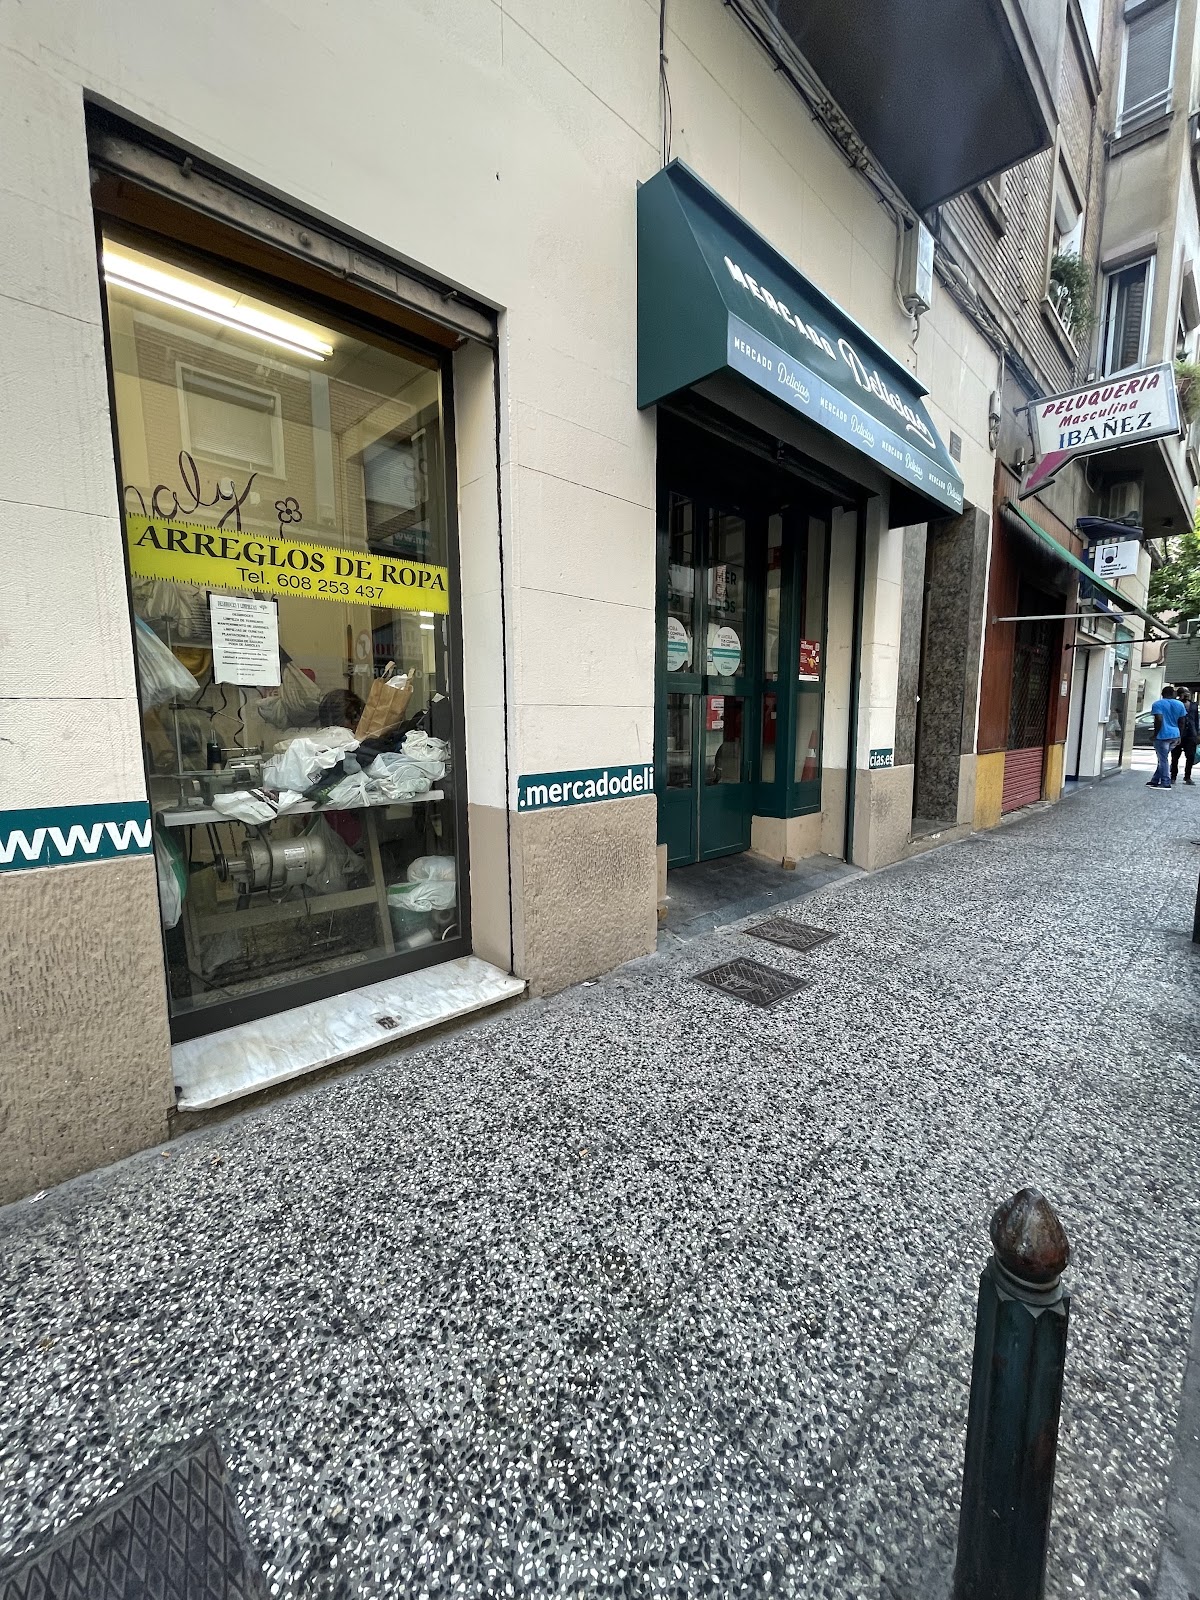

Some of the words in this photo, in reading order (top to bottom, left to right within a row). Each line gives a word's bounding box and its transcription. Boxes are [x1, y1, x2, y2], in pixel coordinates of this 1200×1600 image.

[724, 255, 837, 361] MERCADO
[838, 338, 936, 449] Delicias
[734, 336, 772, 371] MERCADO
[778, 362, 811, 404] Delicias
[820, 396, 848, 423] MERCADO
[851, 414, 875, 449] Delicias
[882, 440, 903, 461] MERCADO
[905, 453, 923, 480] Delicias
[1042, 373, 1160, 418] PELUQUERIA
[1059, 399, 1138, 428] Masculina
[1059, 412, 1152, 449] IBAÑEZ
[134, 525, 326, 573] ARREGLOS
[334, 556, 373, 581] DE
[380, 563, 447, 592] ROPA
[236, 567, 270, 585] Tel.
[277, 574, 312, 590] 608
[318, 579, 350, 595] 253
[355, 584, 385, 600] 437
[870, 751, 893, 767] cias.es
[520, 767, 654, 807] .mercadodeli
